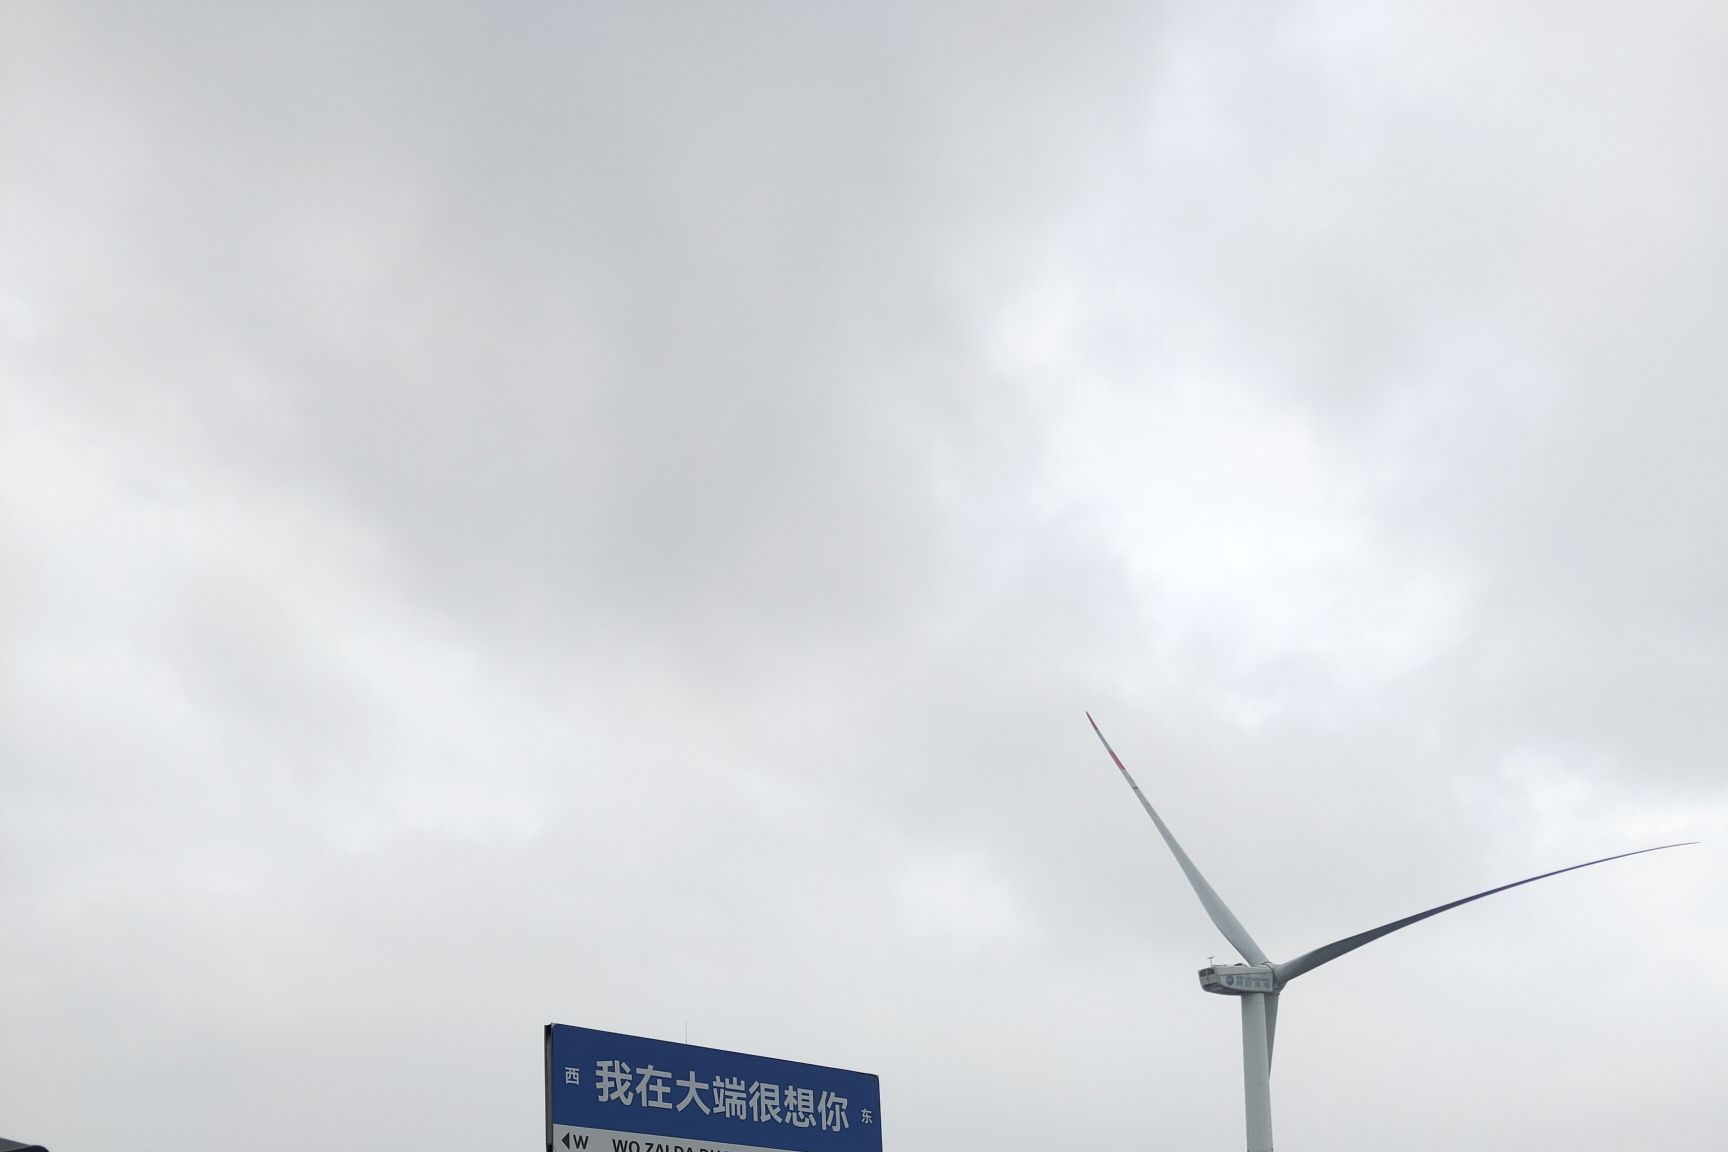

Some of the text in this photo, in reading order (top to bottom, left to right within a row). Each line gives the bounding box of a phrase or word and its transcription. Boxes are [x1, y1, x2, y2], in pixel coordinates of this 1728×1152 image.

[564, 1066, 580, 1086] 西
[595, 1059, 850, 1132] 我在大端很想你
[860, 1108, 873, 1125] 东
[573, 1134, 589, 1150] W
